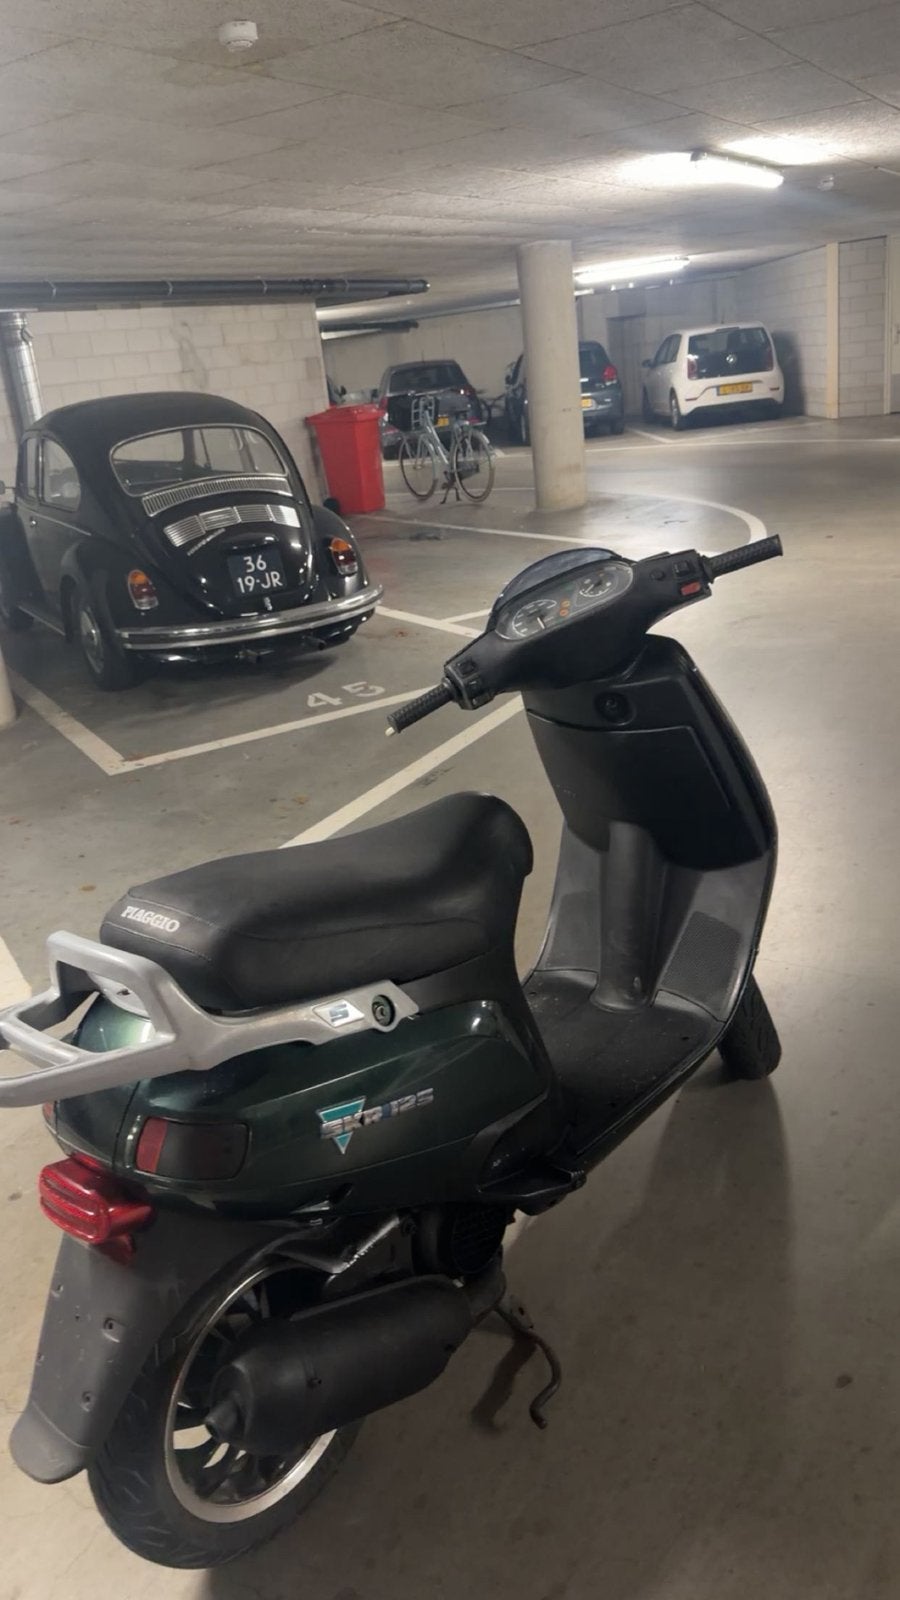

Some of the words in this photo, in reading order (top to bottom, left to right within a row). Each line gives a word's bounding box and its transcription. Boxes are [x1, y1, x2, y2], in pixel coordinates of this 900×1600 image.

[243, 554, 267, 573] 36
[237, 570, 283, 593] 19-JR
[307, 681, 386, 708] 45
[121, 905, 180, 933] PIAGGIO
